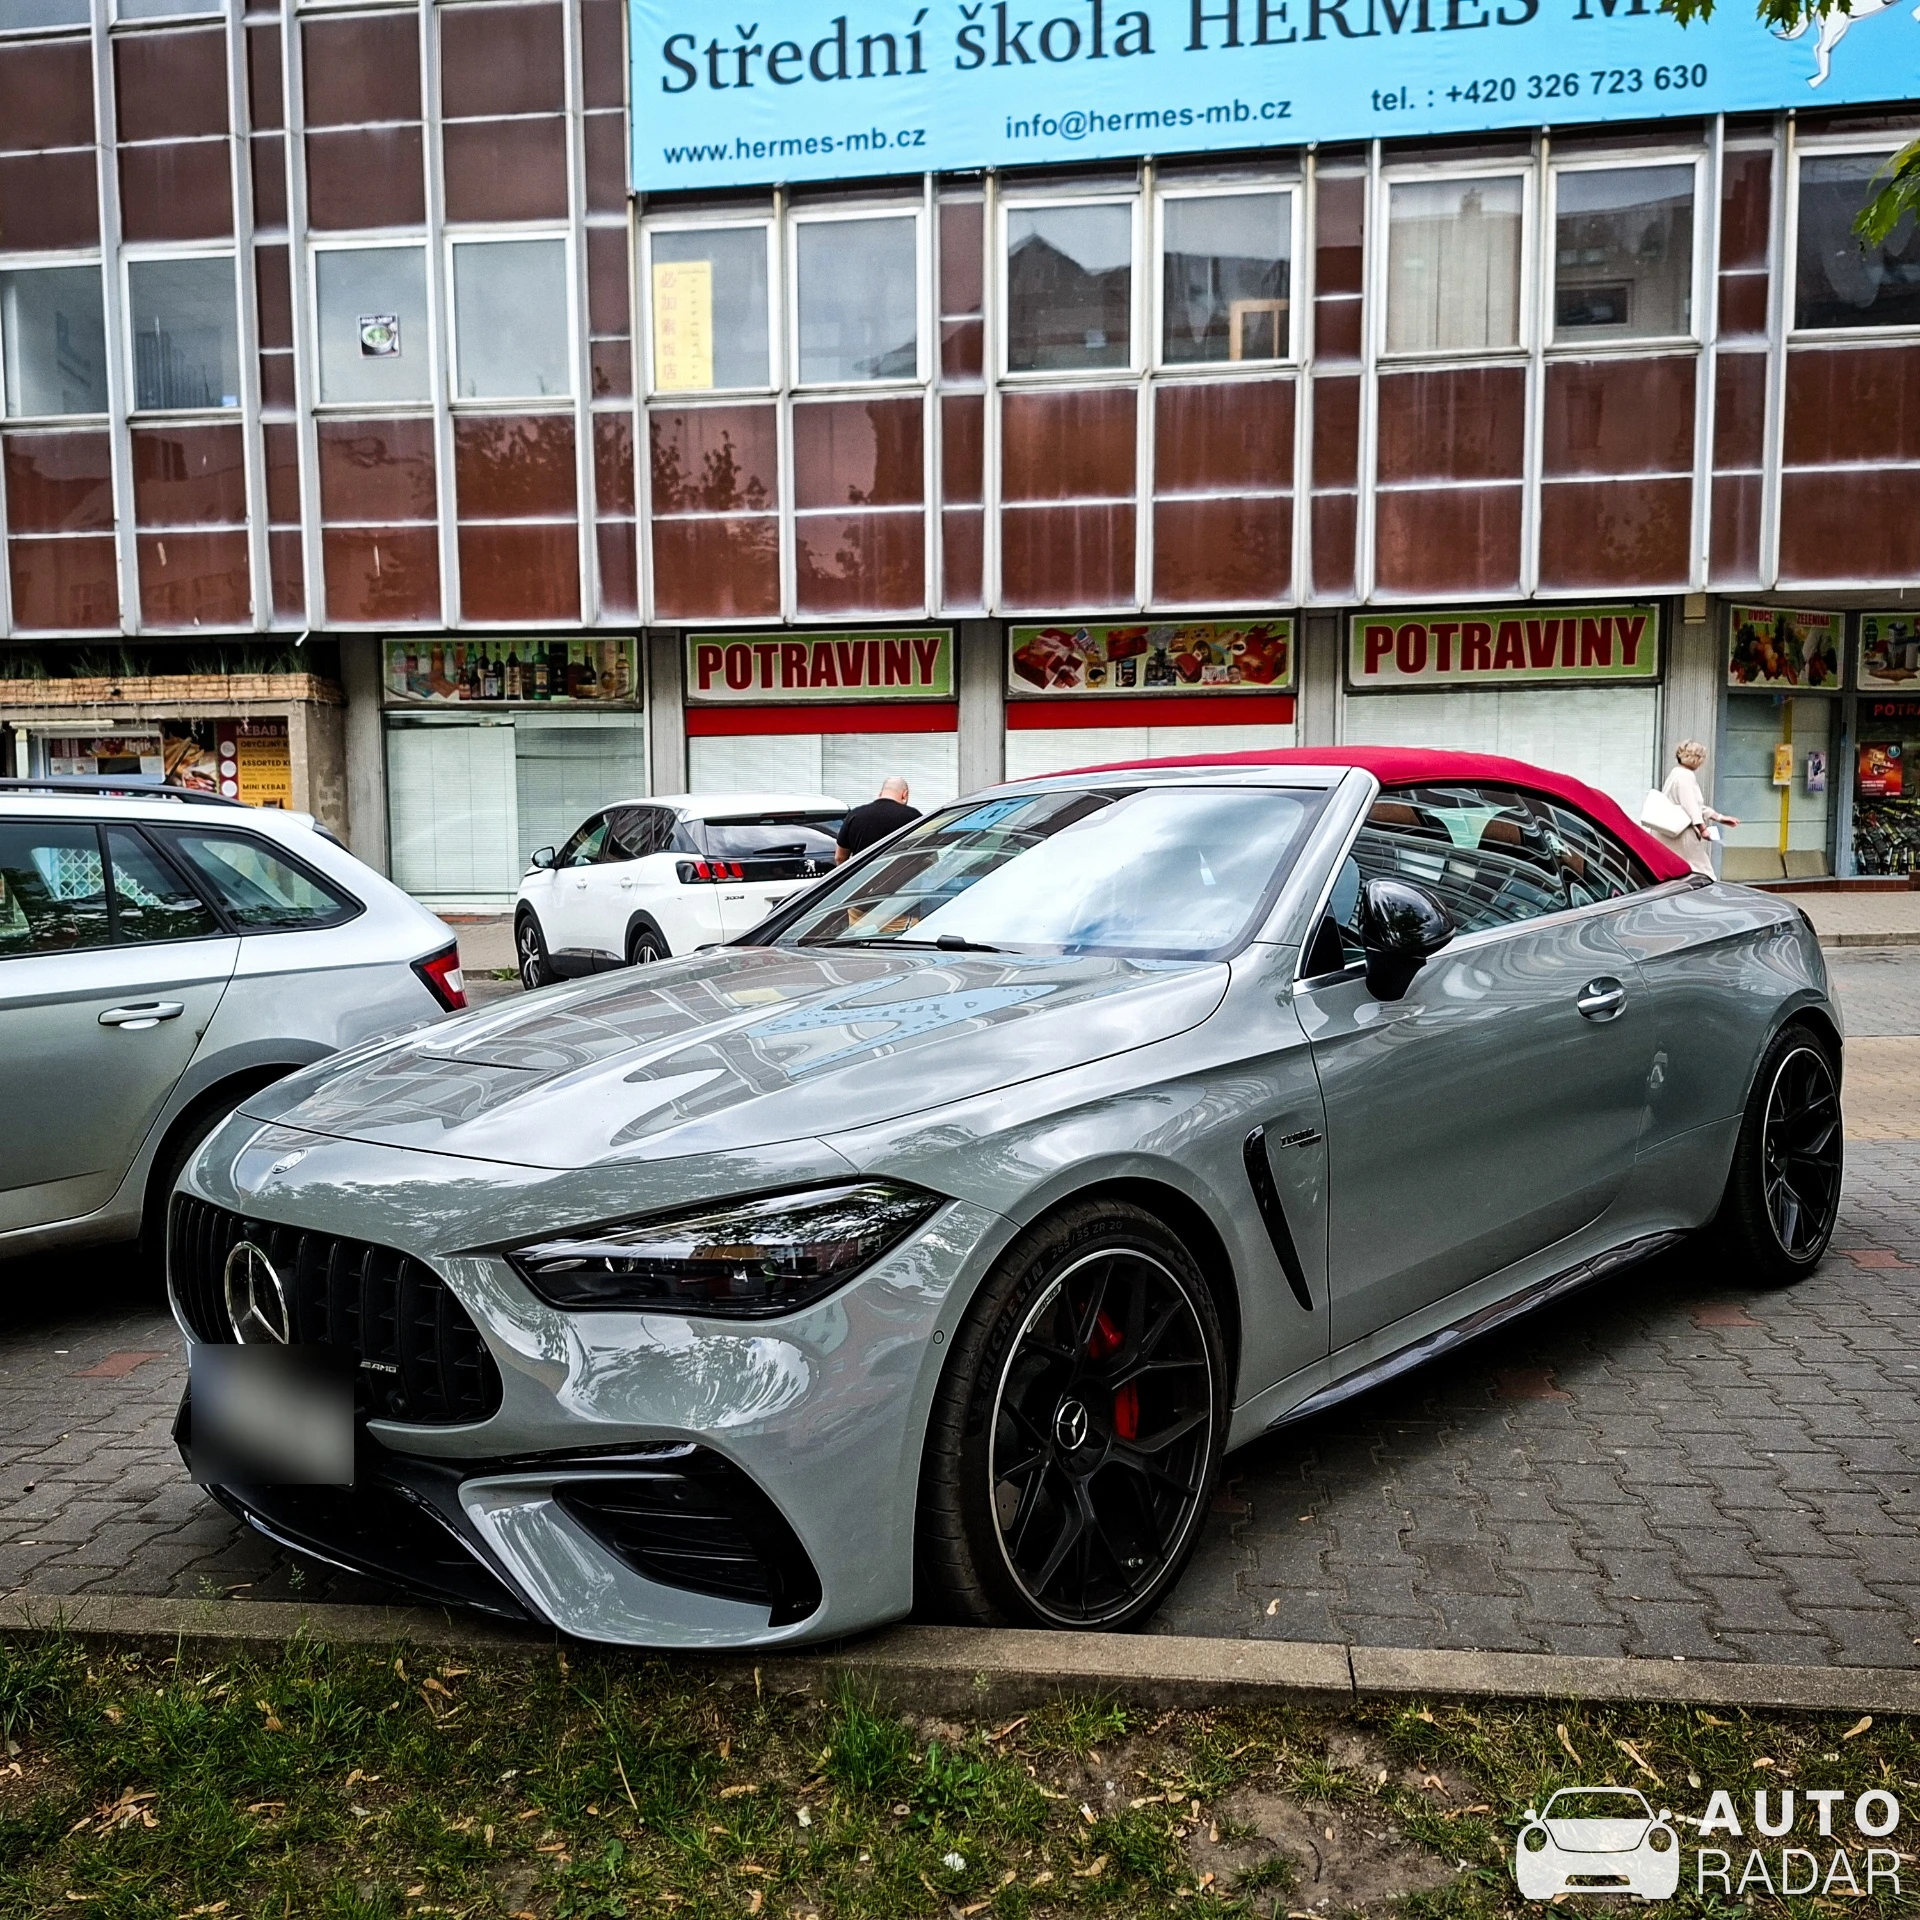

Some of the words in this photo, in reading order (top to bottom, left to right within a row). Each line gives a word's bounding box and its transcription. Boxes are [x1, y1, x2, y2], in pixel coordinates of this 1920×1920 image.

[661, 7, 928, 94] Střední
[955, 0, 1156, 70] škola
[1371, 85, 1415, 112] tel.
[1445, 77, 1517, 104] +420
[1527, 73, 1580, 99] 326
[1590, 68, 1643, 95] 723
[1653, 63, 1708, 90] 630
[1005, 98, 1292, 141] info@hermes-mb.cz
[663, 126, 926, 164] www.hermes-mb.cz
[697, 637, 942, 691] POTRAVINY
[1363, 616, 1647, 675] POTRAVINY
[236, 725, 278, 736] KEBAB
[1109, 1220, 1123, 1230] 20
[977, 1260, 1045, 1390] MICHELIN
